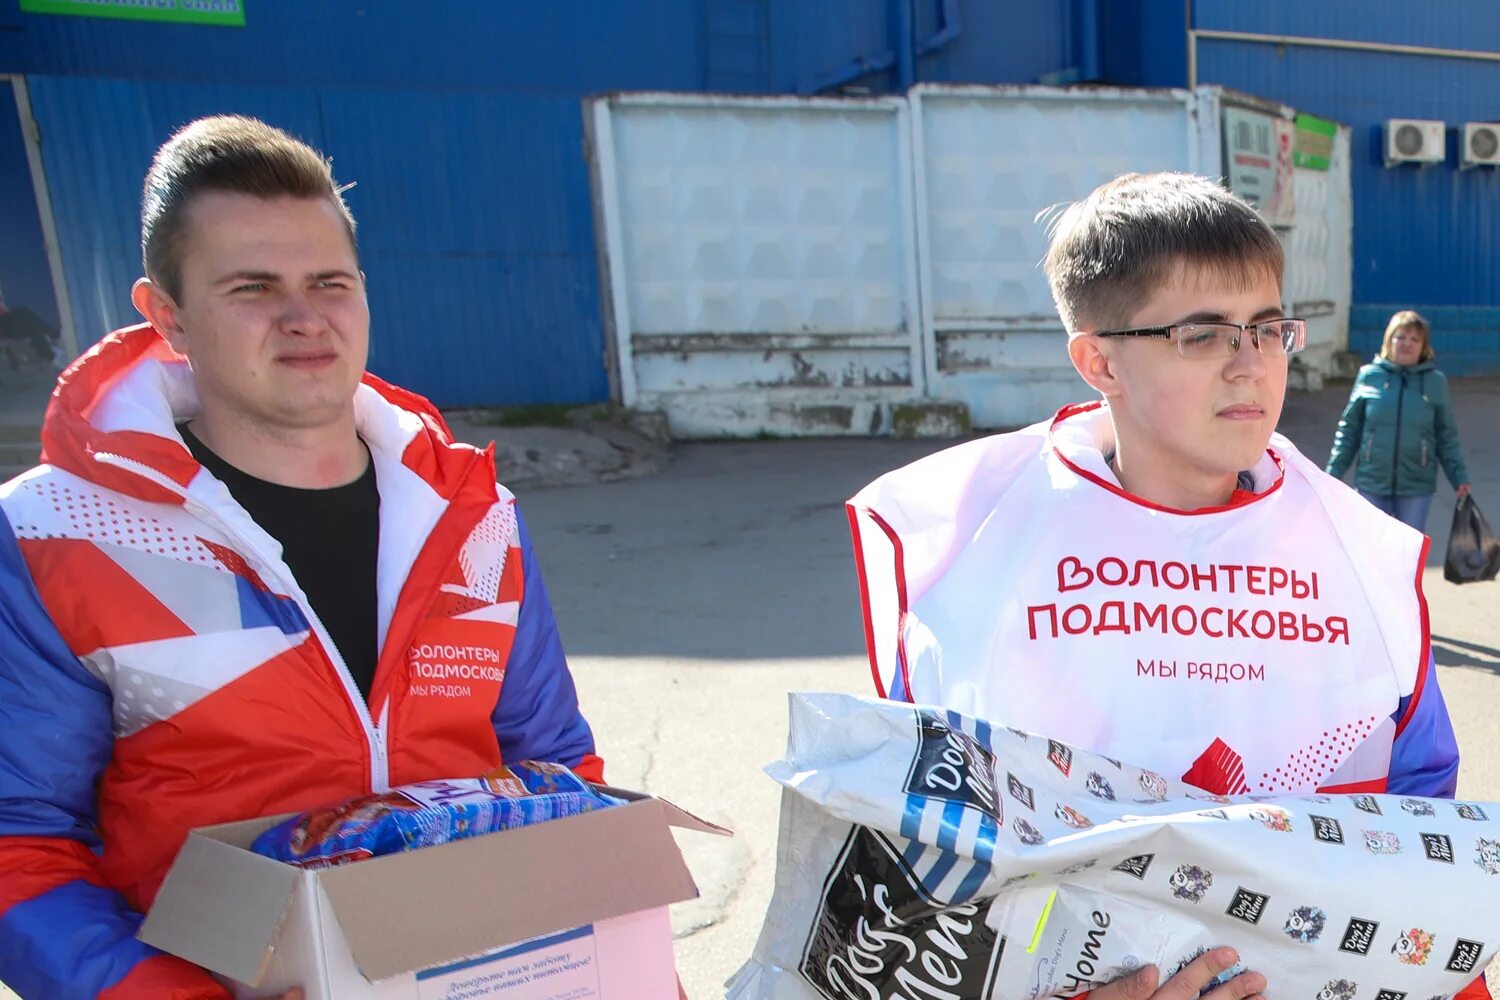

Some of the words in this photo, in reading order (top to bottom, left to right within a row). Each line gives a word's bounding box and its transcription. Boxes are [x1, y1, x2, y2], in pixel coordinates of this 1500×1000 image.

[1057, 556, 1319, 600] ВОЛОНТЕРЫ
[1027, 600, 1350, 645] ПОДМОСКОВЬЯ
[1136, 659, 1177, 678] МЫ
[1187, 661, 1265, 683] РЯДОМ
[409, 684, 428, 697] МЫ
[430, 684, 472, 698] РЯДОМ
[1232, 894, 1253, 918] Dog's
[1245, 895, 1265, 923] Menu
[1344, 922, 1364, 950] Dog's
[1356, 923, 1375, 953] Menu
[1451, 943, 1470, 970] Dog's
[1461, 944, 1480, 973] Menu
